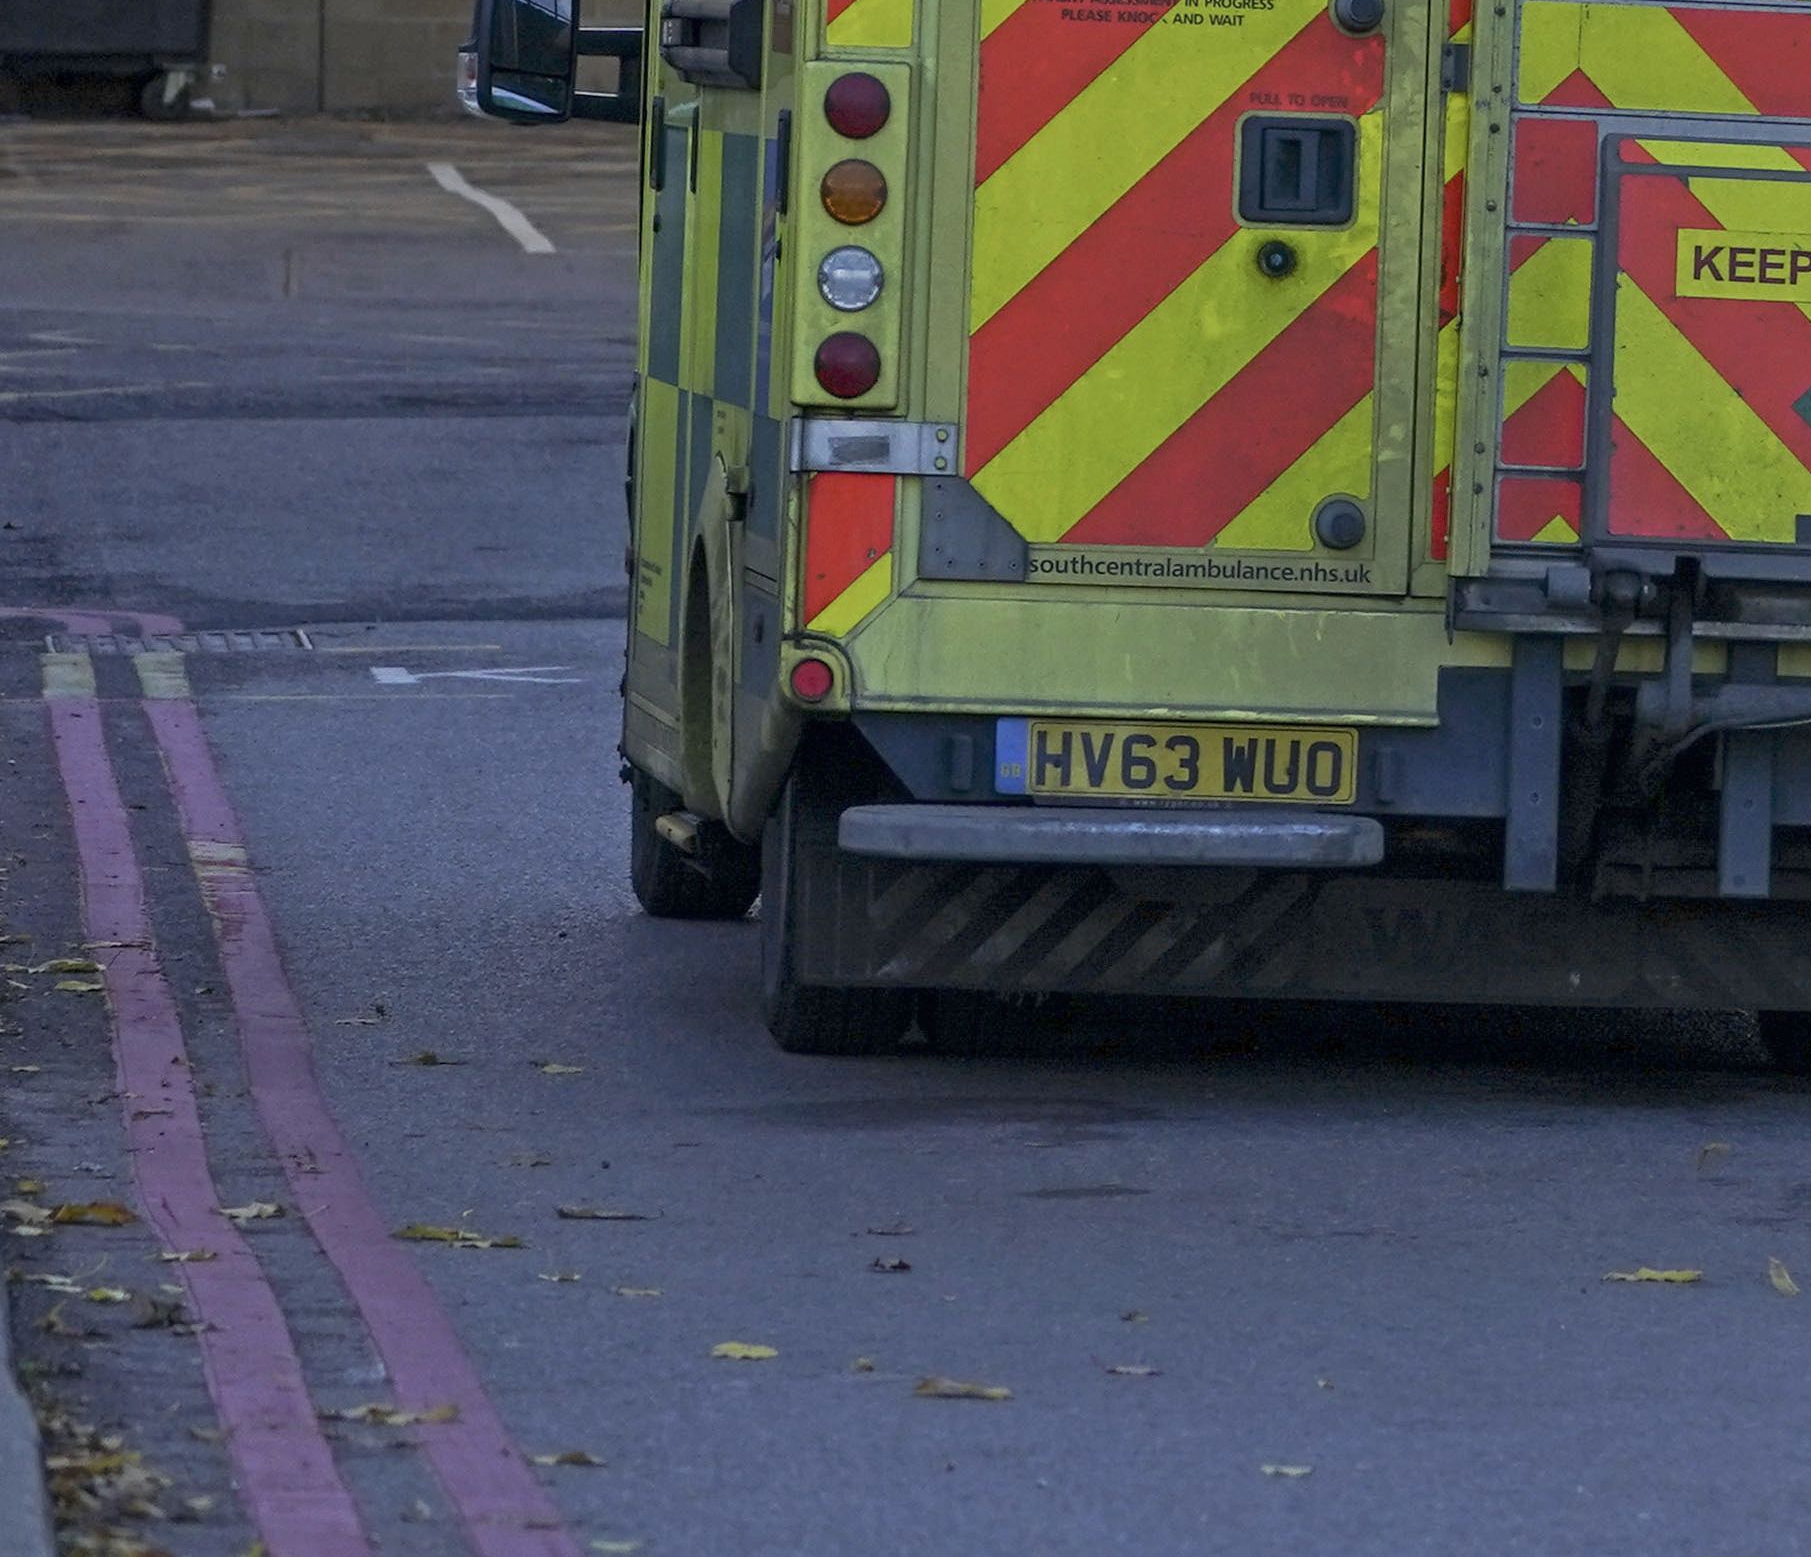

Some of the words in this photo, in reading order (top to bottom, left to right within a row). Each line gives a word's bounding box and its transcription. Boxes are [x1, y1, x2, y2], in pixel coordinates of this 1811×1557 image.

[1060, 7, 1112, 22] PLEASE
[1172, 12, 1204, 26] AND
[1210, 13, 1245, 27] WAIT
[1249, 91, 1281, 106] PULL
[1287, 92, 1305, 107] TO
[1310, 94, 1349, 109] OPEN
[1028, 554, 1372, 586] southcentralambulance.nhs.uk
[1034, 729, 1200, 791] HV63
[1222, 736, 1343, 798] WUO
